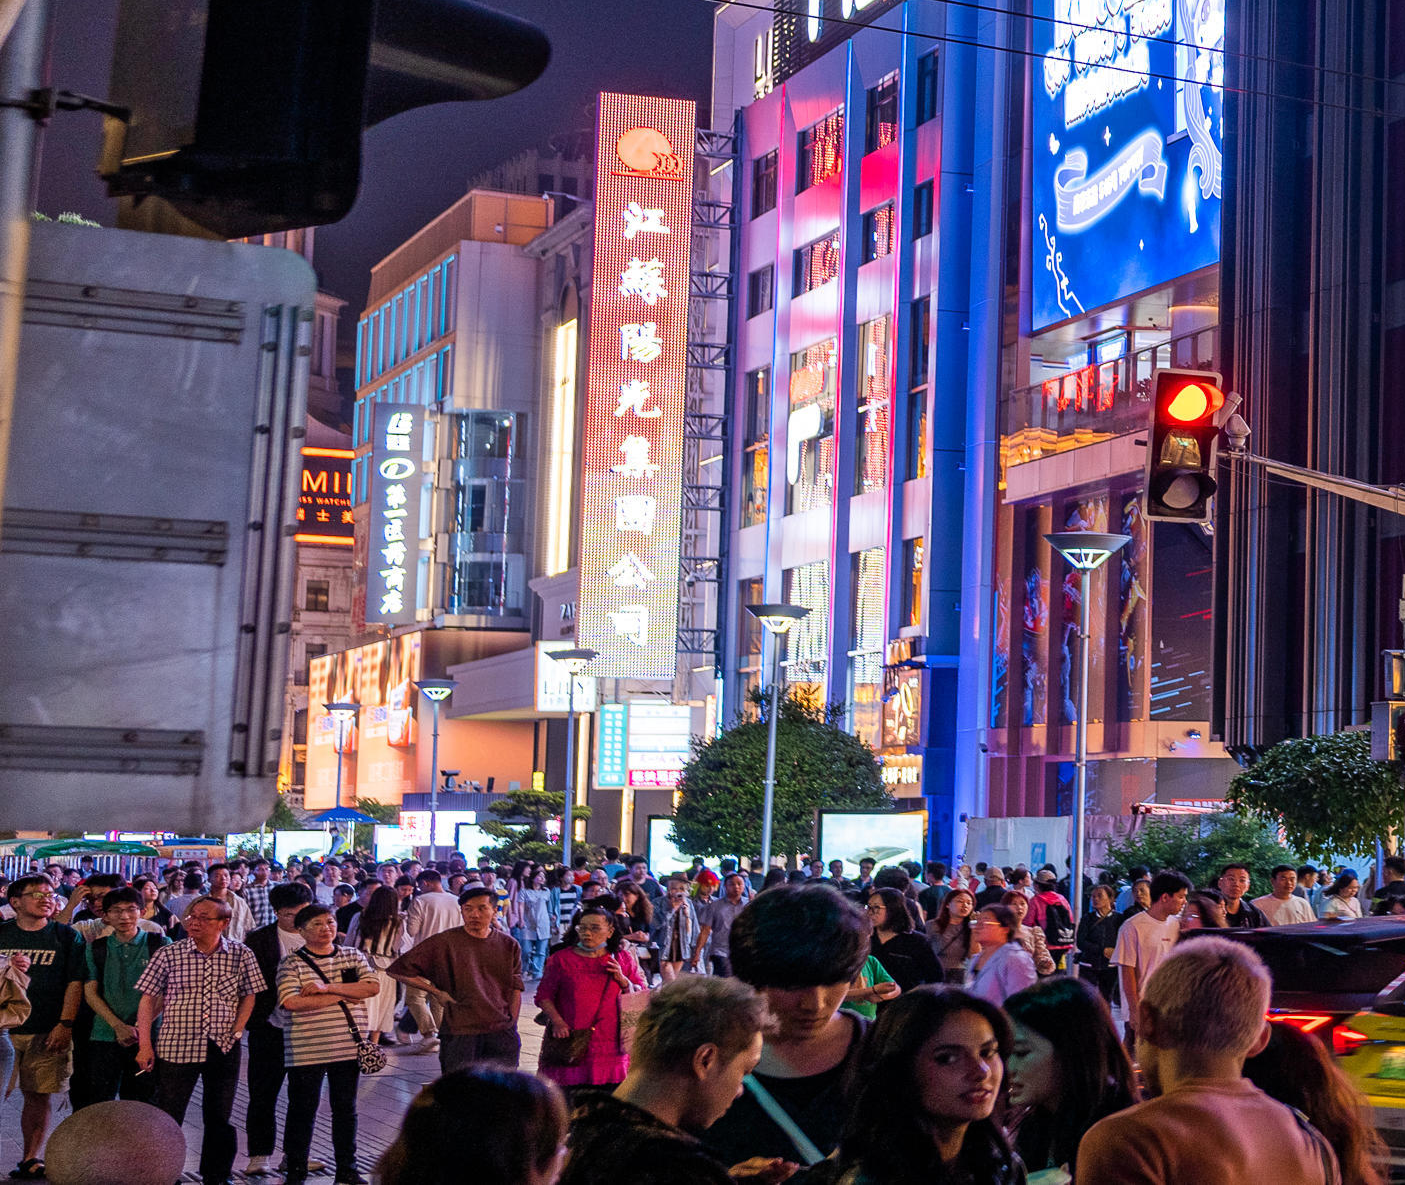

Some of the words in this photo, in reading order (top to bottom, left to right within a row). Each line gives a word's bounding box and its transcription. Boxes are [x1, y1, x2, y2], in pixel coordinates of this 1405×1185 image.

[606, 201, 671, 648] 江蘇陽光集團公司
